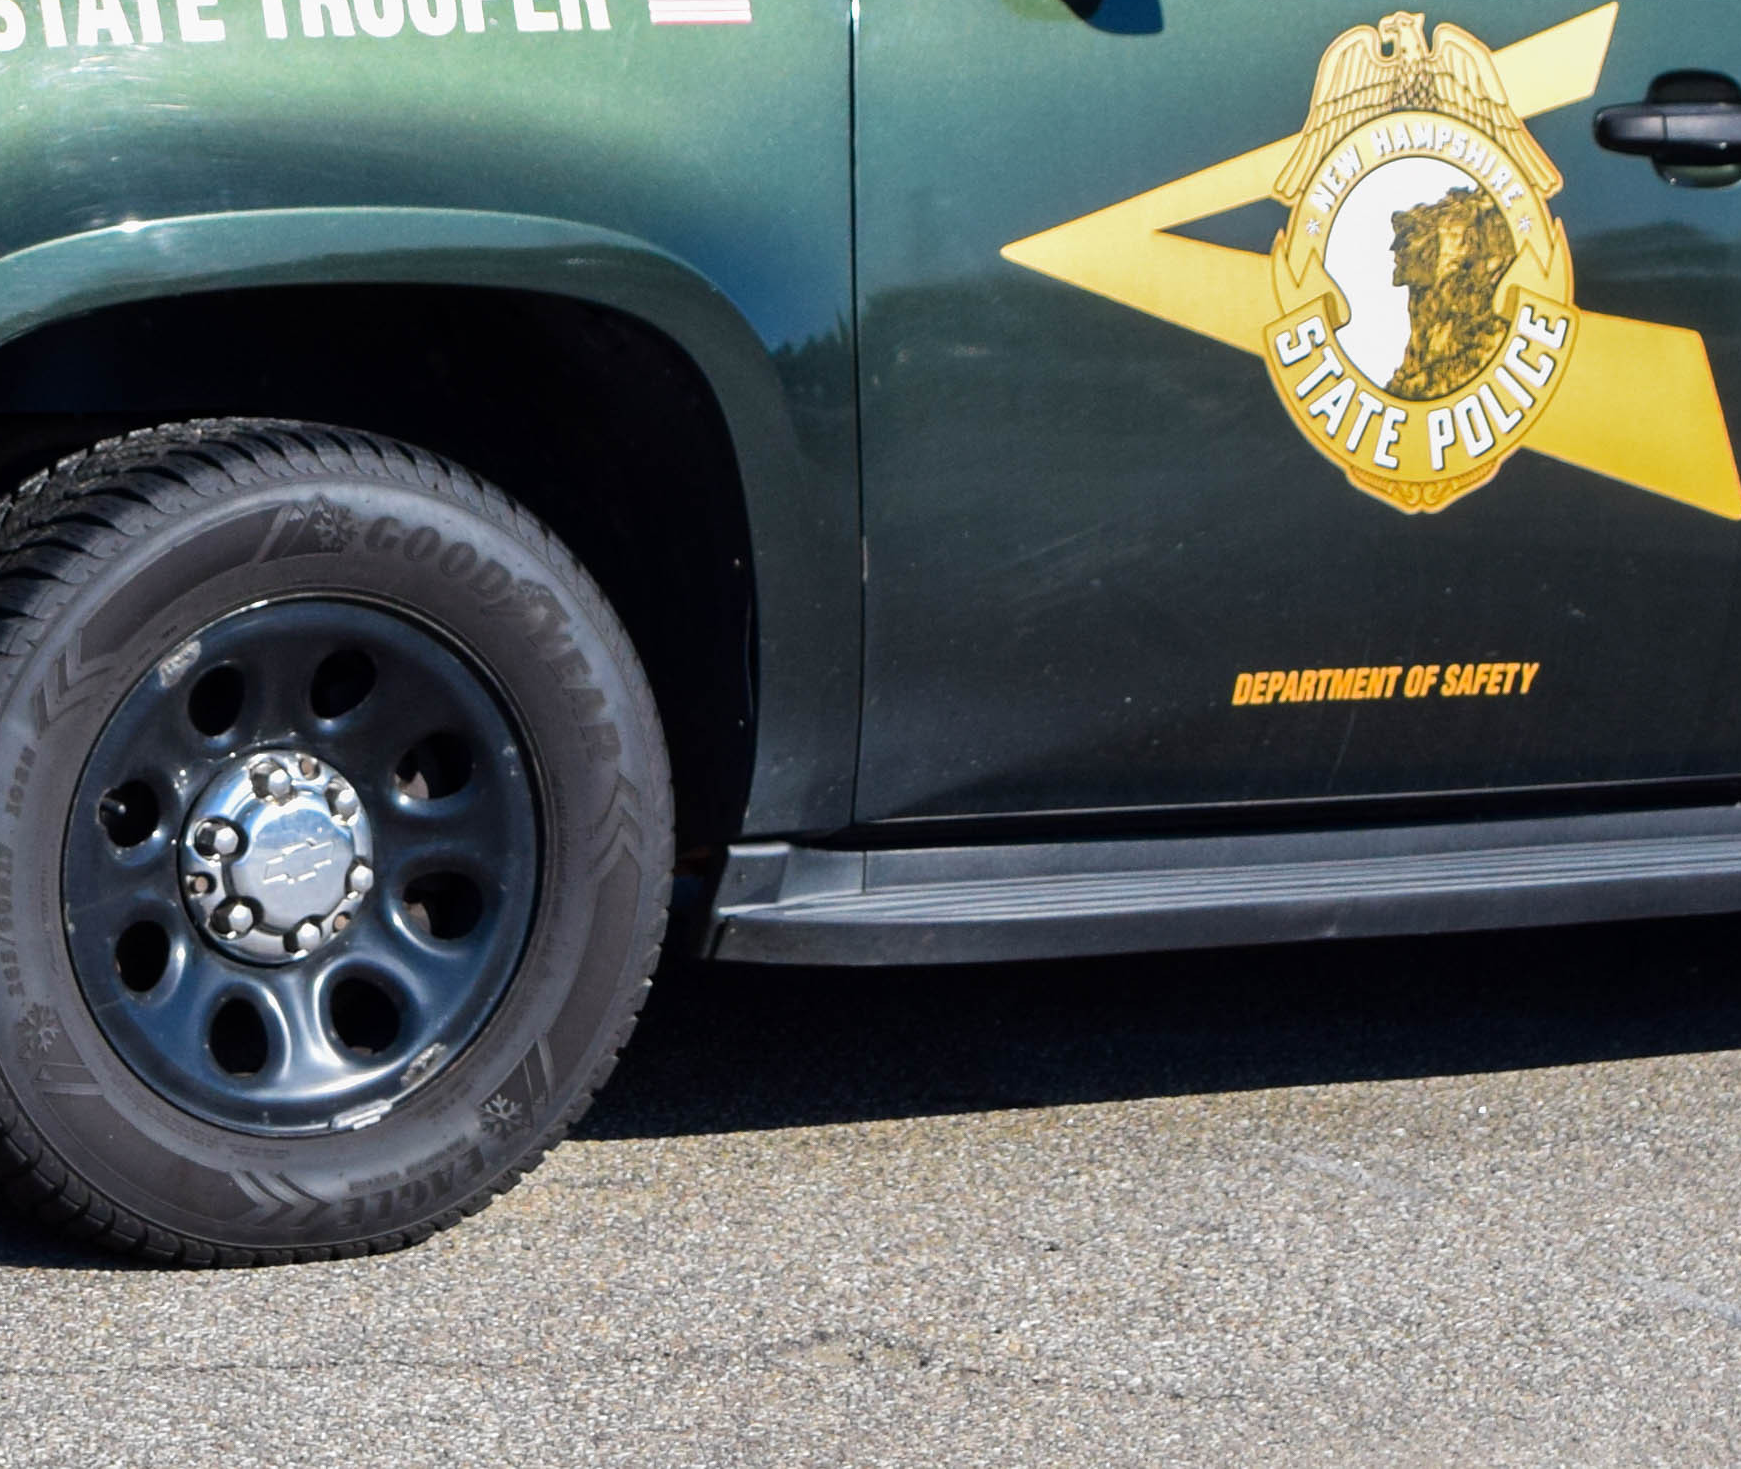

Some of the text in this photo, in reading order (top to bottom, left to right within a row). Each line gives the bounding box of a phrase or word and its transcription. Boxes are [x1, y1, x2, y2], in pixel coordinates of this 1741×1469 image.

[1309, 120, 1525, 214] NEW HAMPSHIRE
[1275, 304, 1569, 471] STATE POLICE
[364, 515, 623, 763] GOODYEAR
[1231, 662, 1540, 706] DEPARTMENT OF SAFETY
